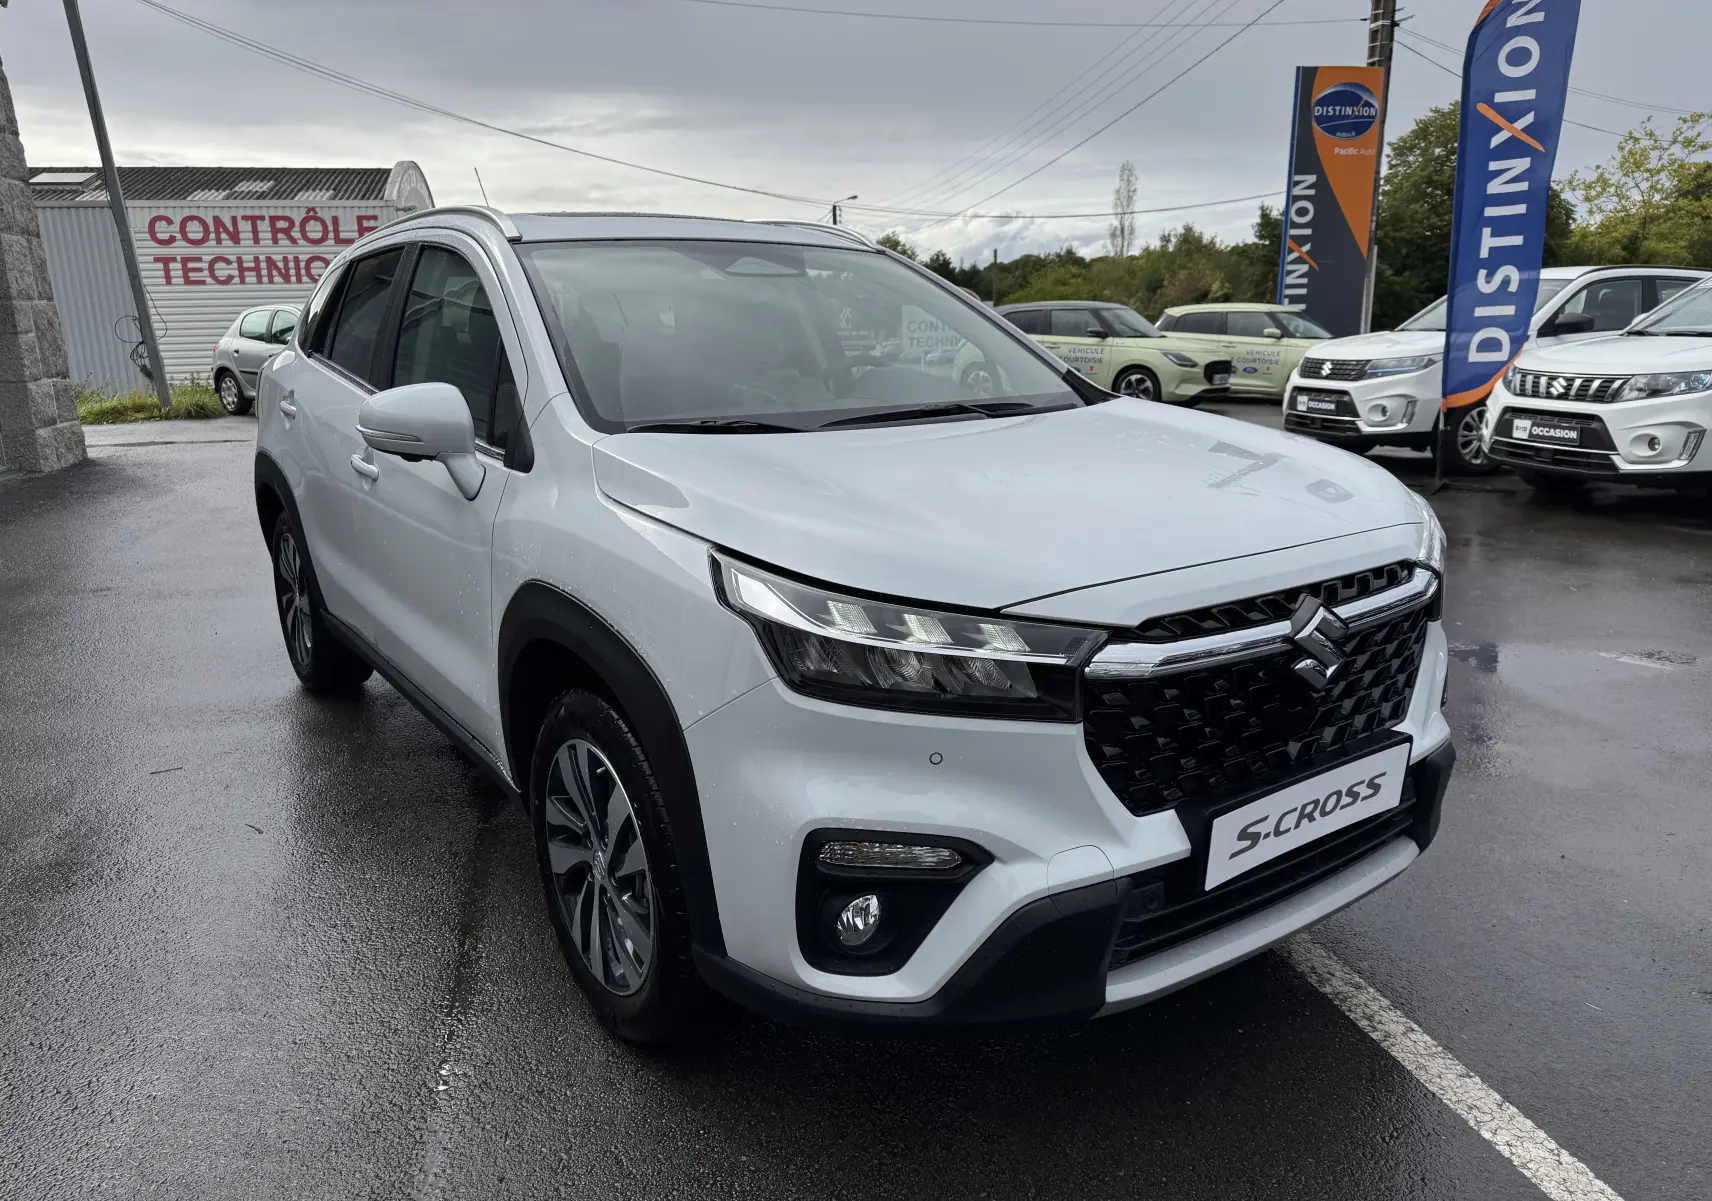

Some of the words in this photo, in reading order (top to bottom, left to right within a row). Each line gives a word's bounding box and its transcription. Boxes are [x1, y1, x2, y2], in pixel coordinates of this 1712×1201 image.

[1314, 103, 1377, 118] DISTINXION
[1334, 147, 1359, 155] Pacific
[1468, 0, 1546, 363] DISTINXION
[148, 207, 378, 246] CONTRÔLE
[1308, 400, 1336, 410] OCCASION
[1532, 426, 1577, 439] OCCASION
[1228, 771, 1387, 860] S.CROSS
